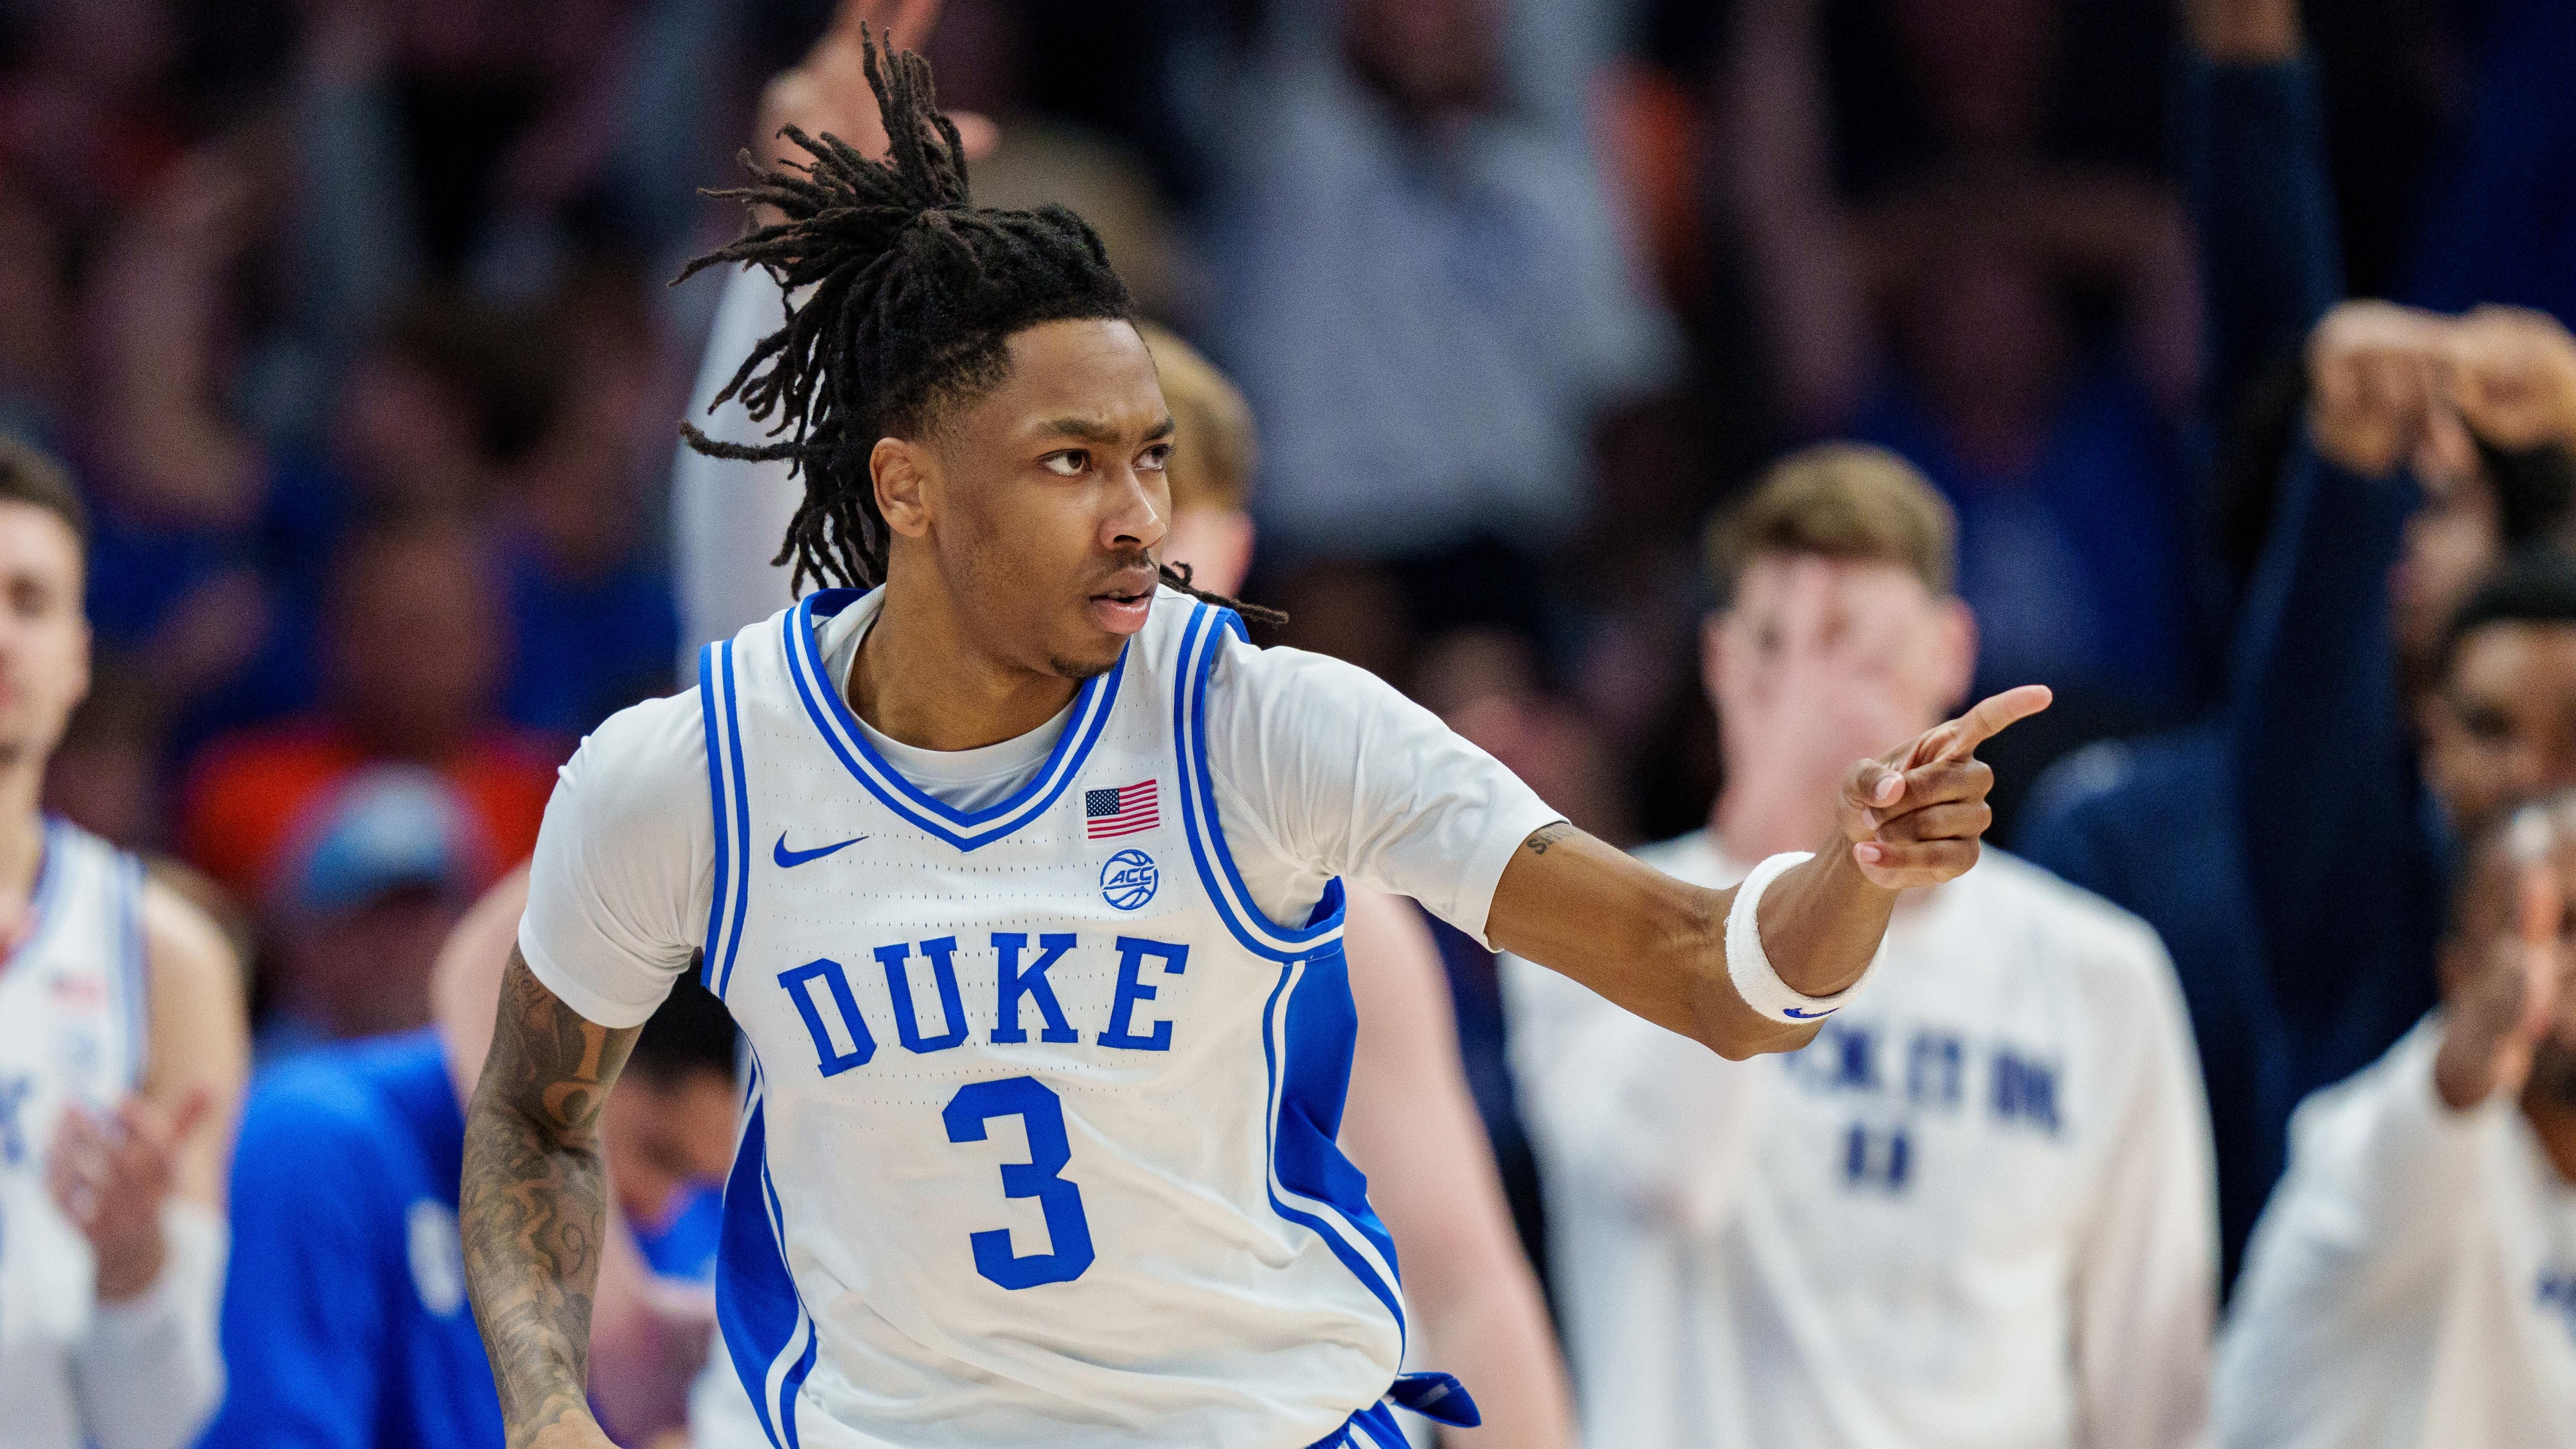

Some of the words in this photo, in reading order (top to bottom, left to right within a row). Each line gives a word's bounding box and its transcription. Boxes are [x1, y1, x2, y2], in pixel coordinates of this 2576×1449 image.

[1108, 865, 1155, 885] ACC
[777, 932, 1190, 1078] DUKE
[942, 1076, 1095, 1291] 3
